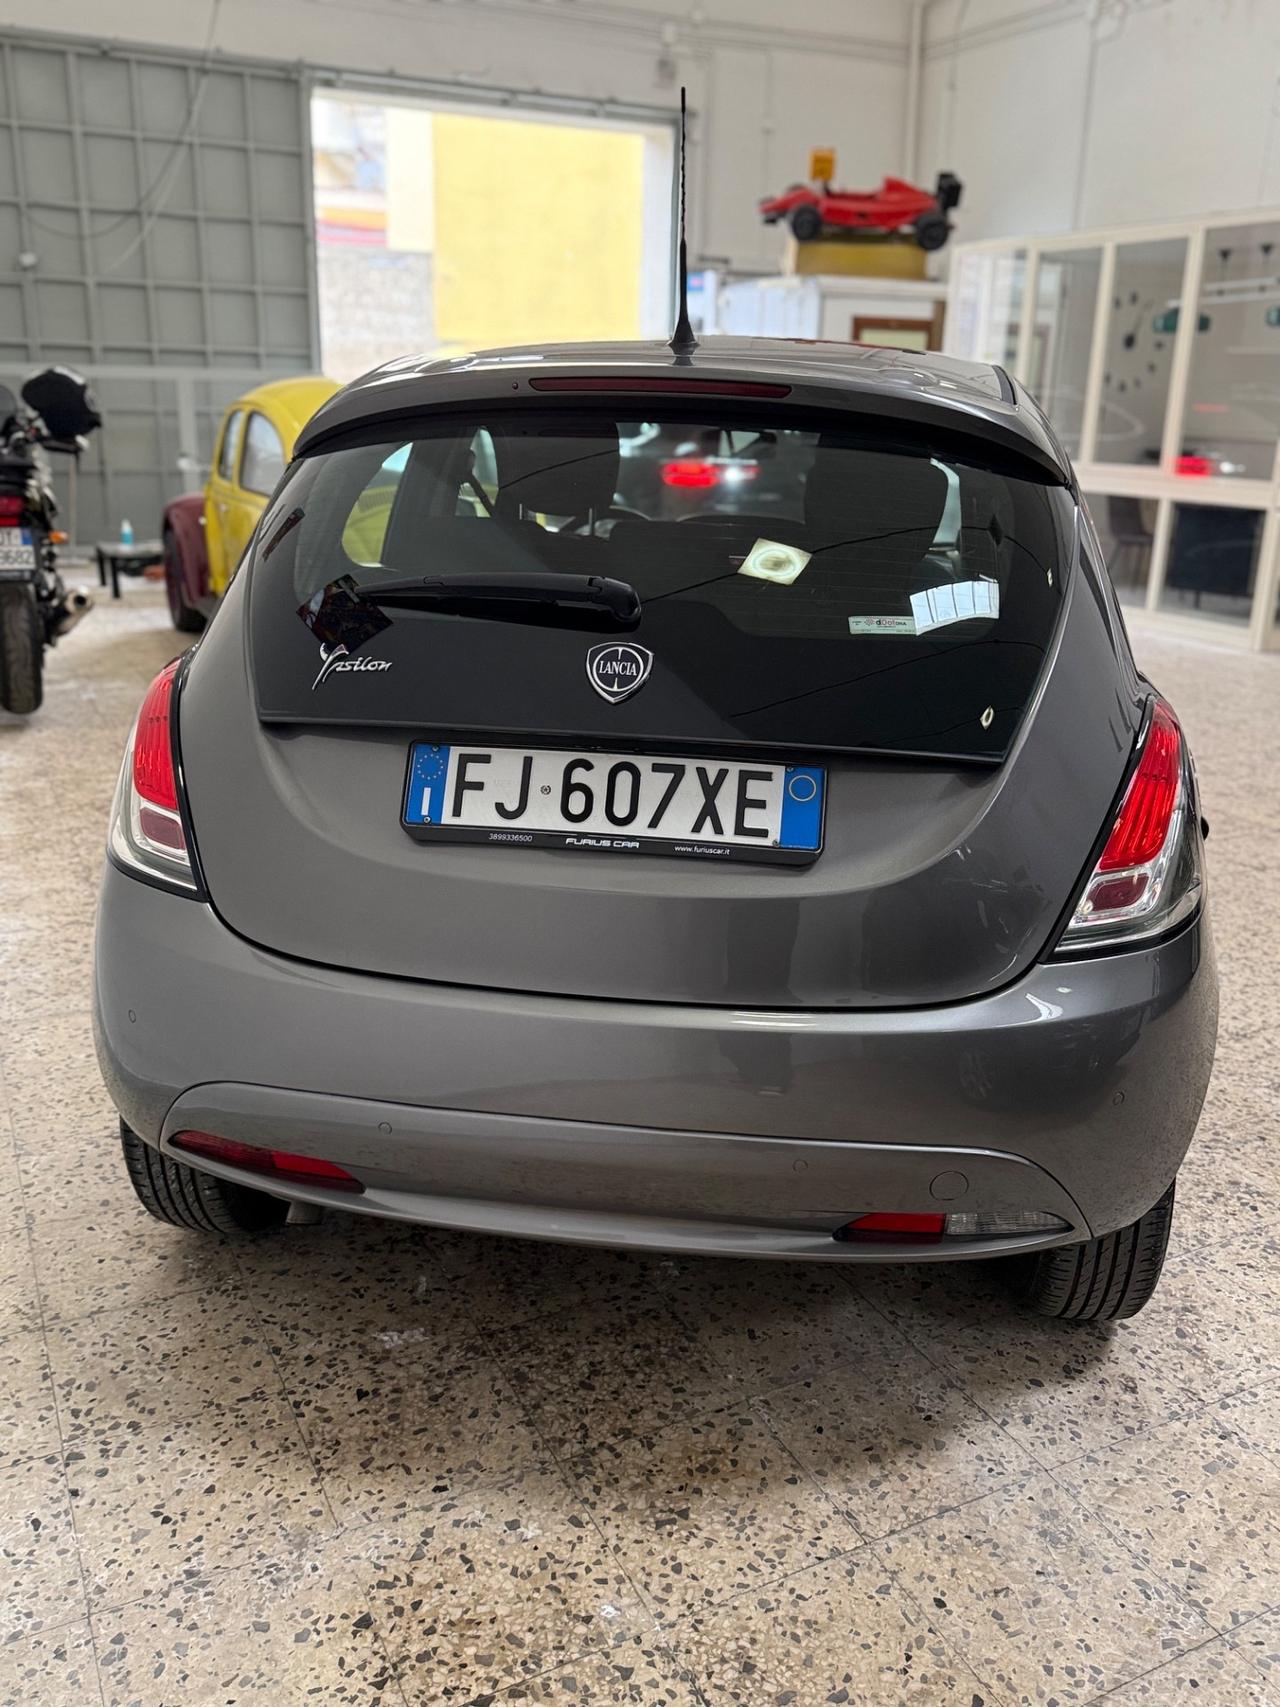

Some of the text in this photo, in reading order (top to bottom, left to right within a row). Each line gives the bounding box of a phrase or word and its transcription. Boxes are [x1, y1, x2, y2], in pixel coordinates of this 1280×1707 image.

[312, 643, 392, 690] Ypsilon
[599, 660, 637, 676] LANCIA
[452, 753, 773, 838] FJ 607XE
[488, 833, 533, 843] 3899336500
[565, 838, 640, 849] FURIUS CAR
[674, 844, 730, 855] www.furiuscar.it
